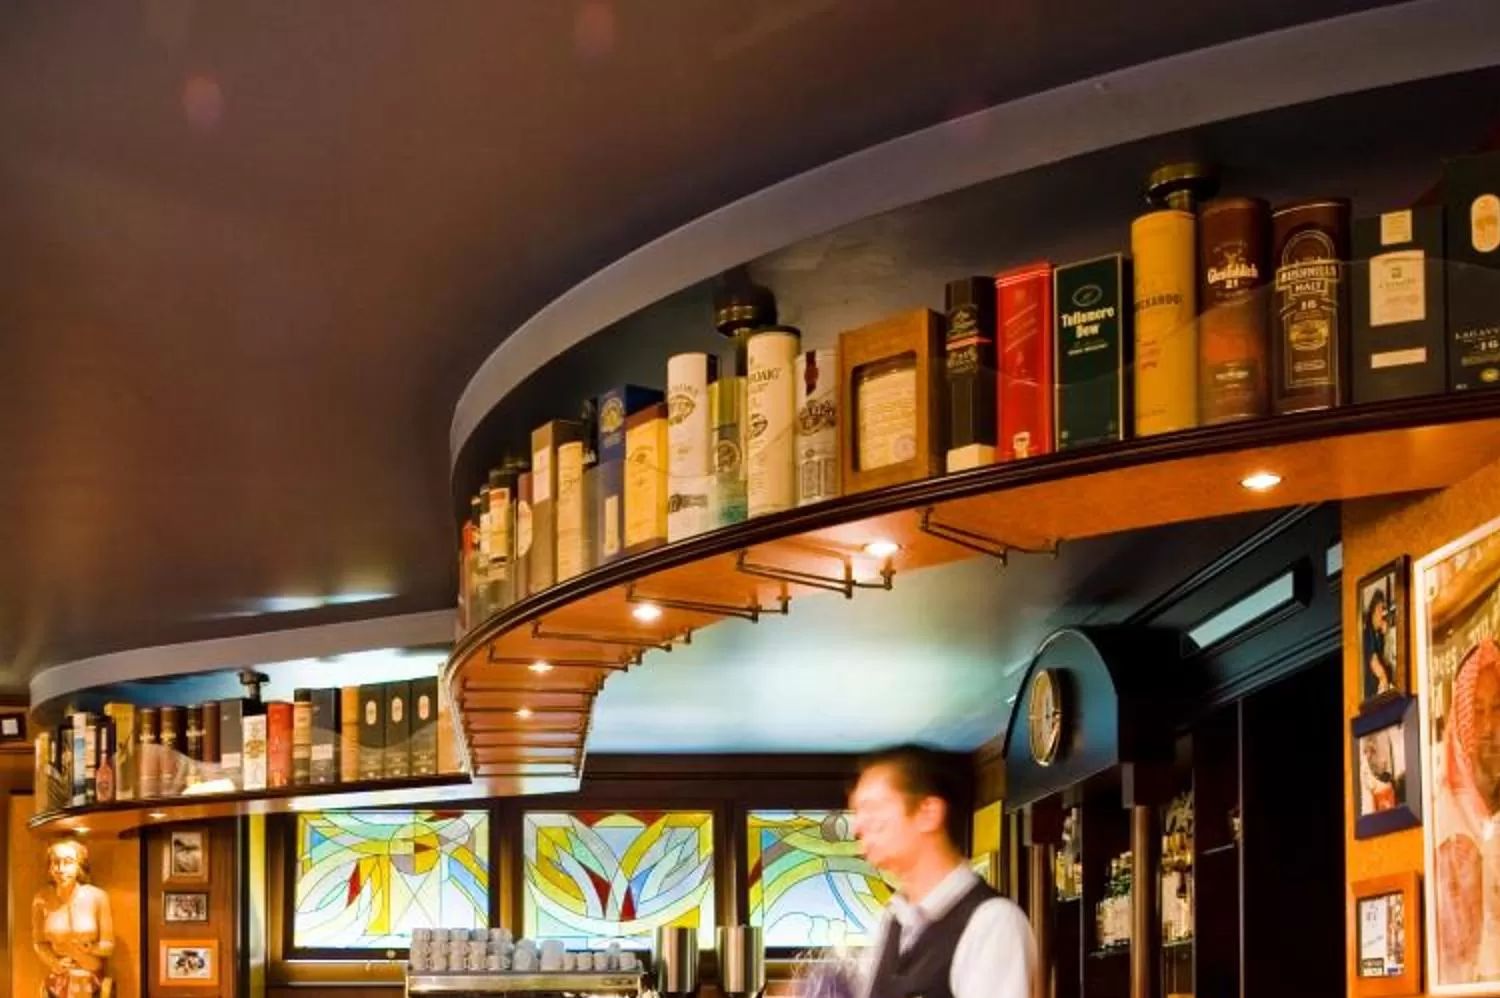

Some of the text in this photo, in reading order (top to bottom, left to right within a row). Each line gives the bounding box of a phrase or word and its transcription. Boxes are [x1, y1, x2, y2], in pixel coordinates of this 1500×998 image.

[1207, 263, 1258, 284] Glenfiddich
[1295, 281, 1321, 292] MALT
[1060, 306, 1115, 328] Tullamore
[1076, 323, 1100, 338] Dew
